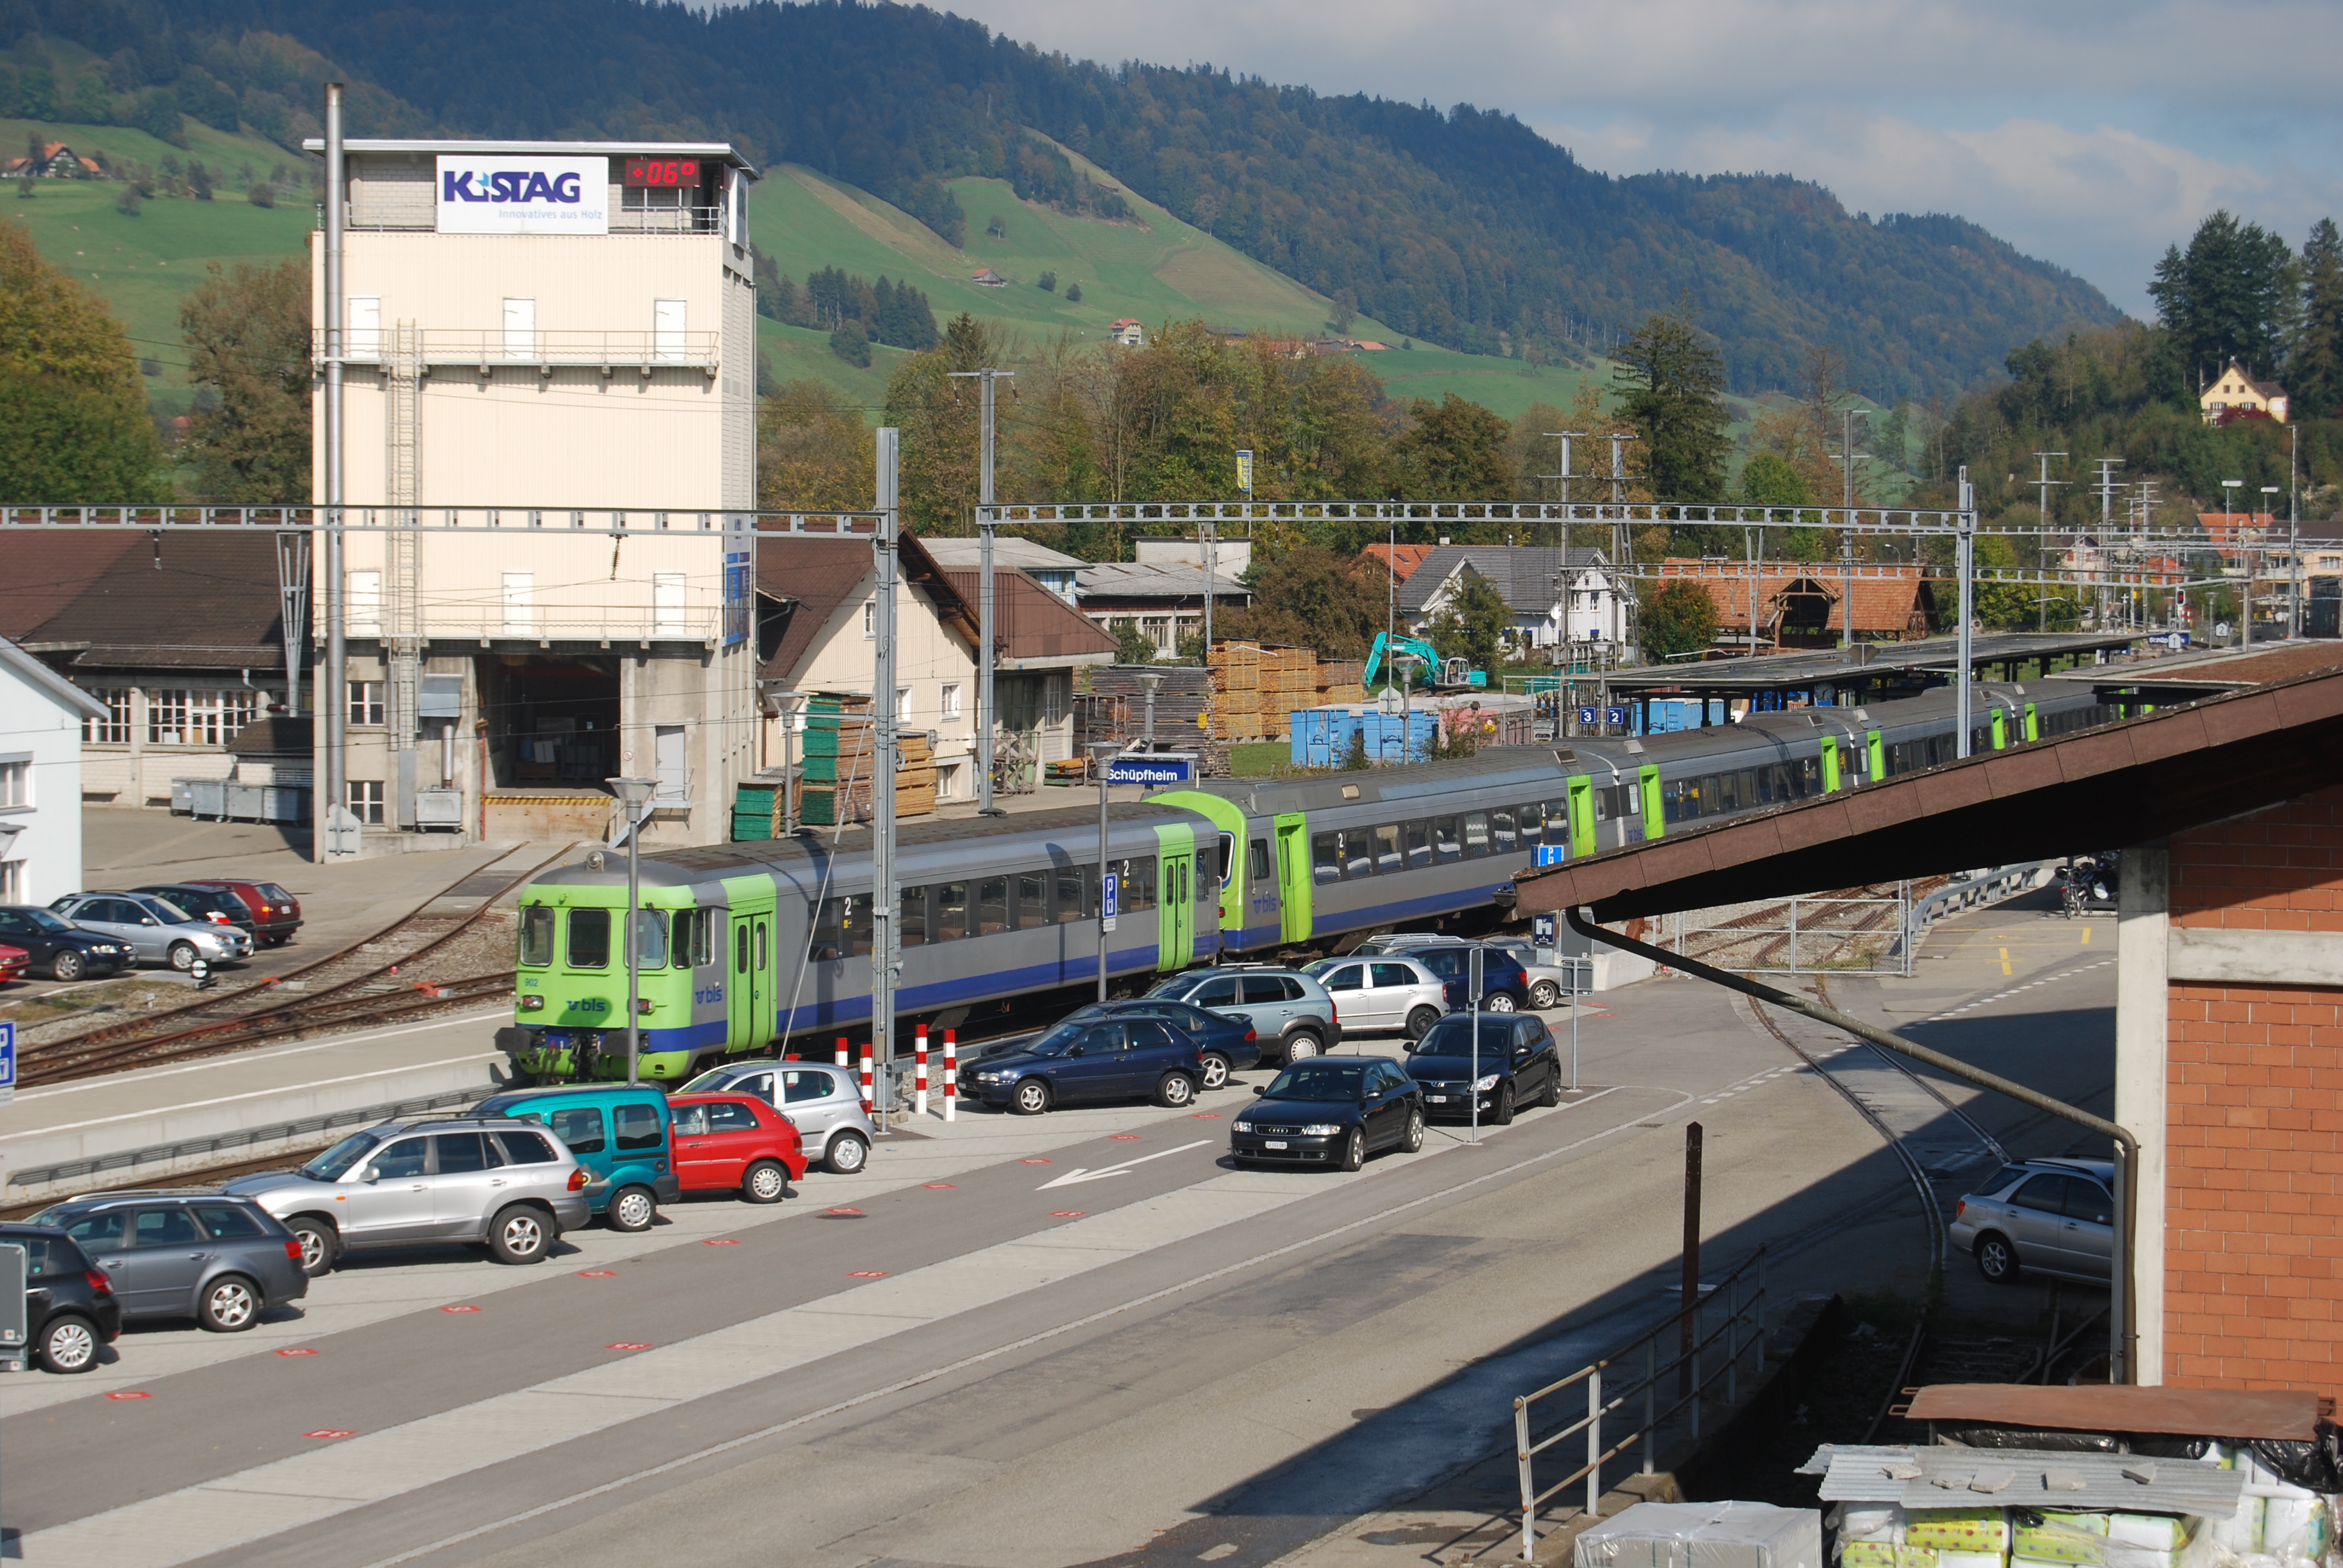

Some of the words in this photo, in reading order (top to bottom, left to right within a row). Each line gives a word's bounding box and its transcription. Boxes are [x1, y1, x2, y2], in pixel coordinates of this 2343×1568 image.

[499, 209, 557, 219] Innovatives
[581, 210, 603, 219] Holz
[1584, 712, 1591, 722] 3
[1611, 713, 1619, 722] 2
[1107, 769, 1178, 783] Schüpfheim
[1541, 803, 1547, 817] 2
[1338, 832, 1344, 848] 2
[1548, 847, 1554, 857] P
[1123, 859, 1130, 877] 2
[1107, 878, 1113, 898] P
[844, 897, 852, 916] 2
[1262, 893, 1277, 913] bls
[524, 978, 539, 987] 902
[706, 984, 723, 1004] bls
[582, 998, 606, 1012] bls
